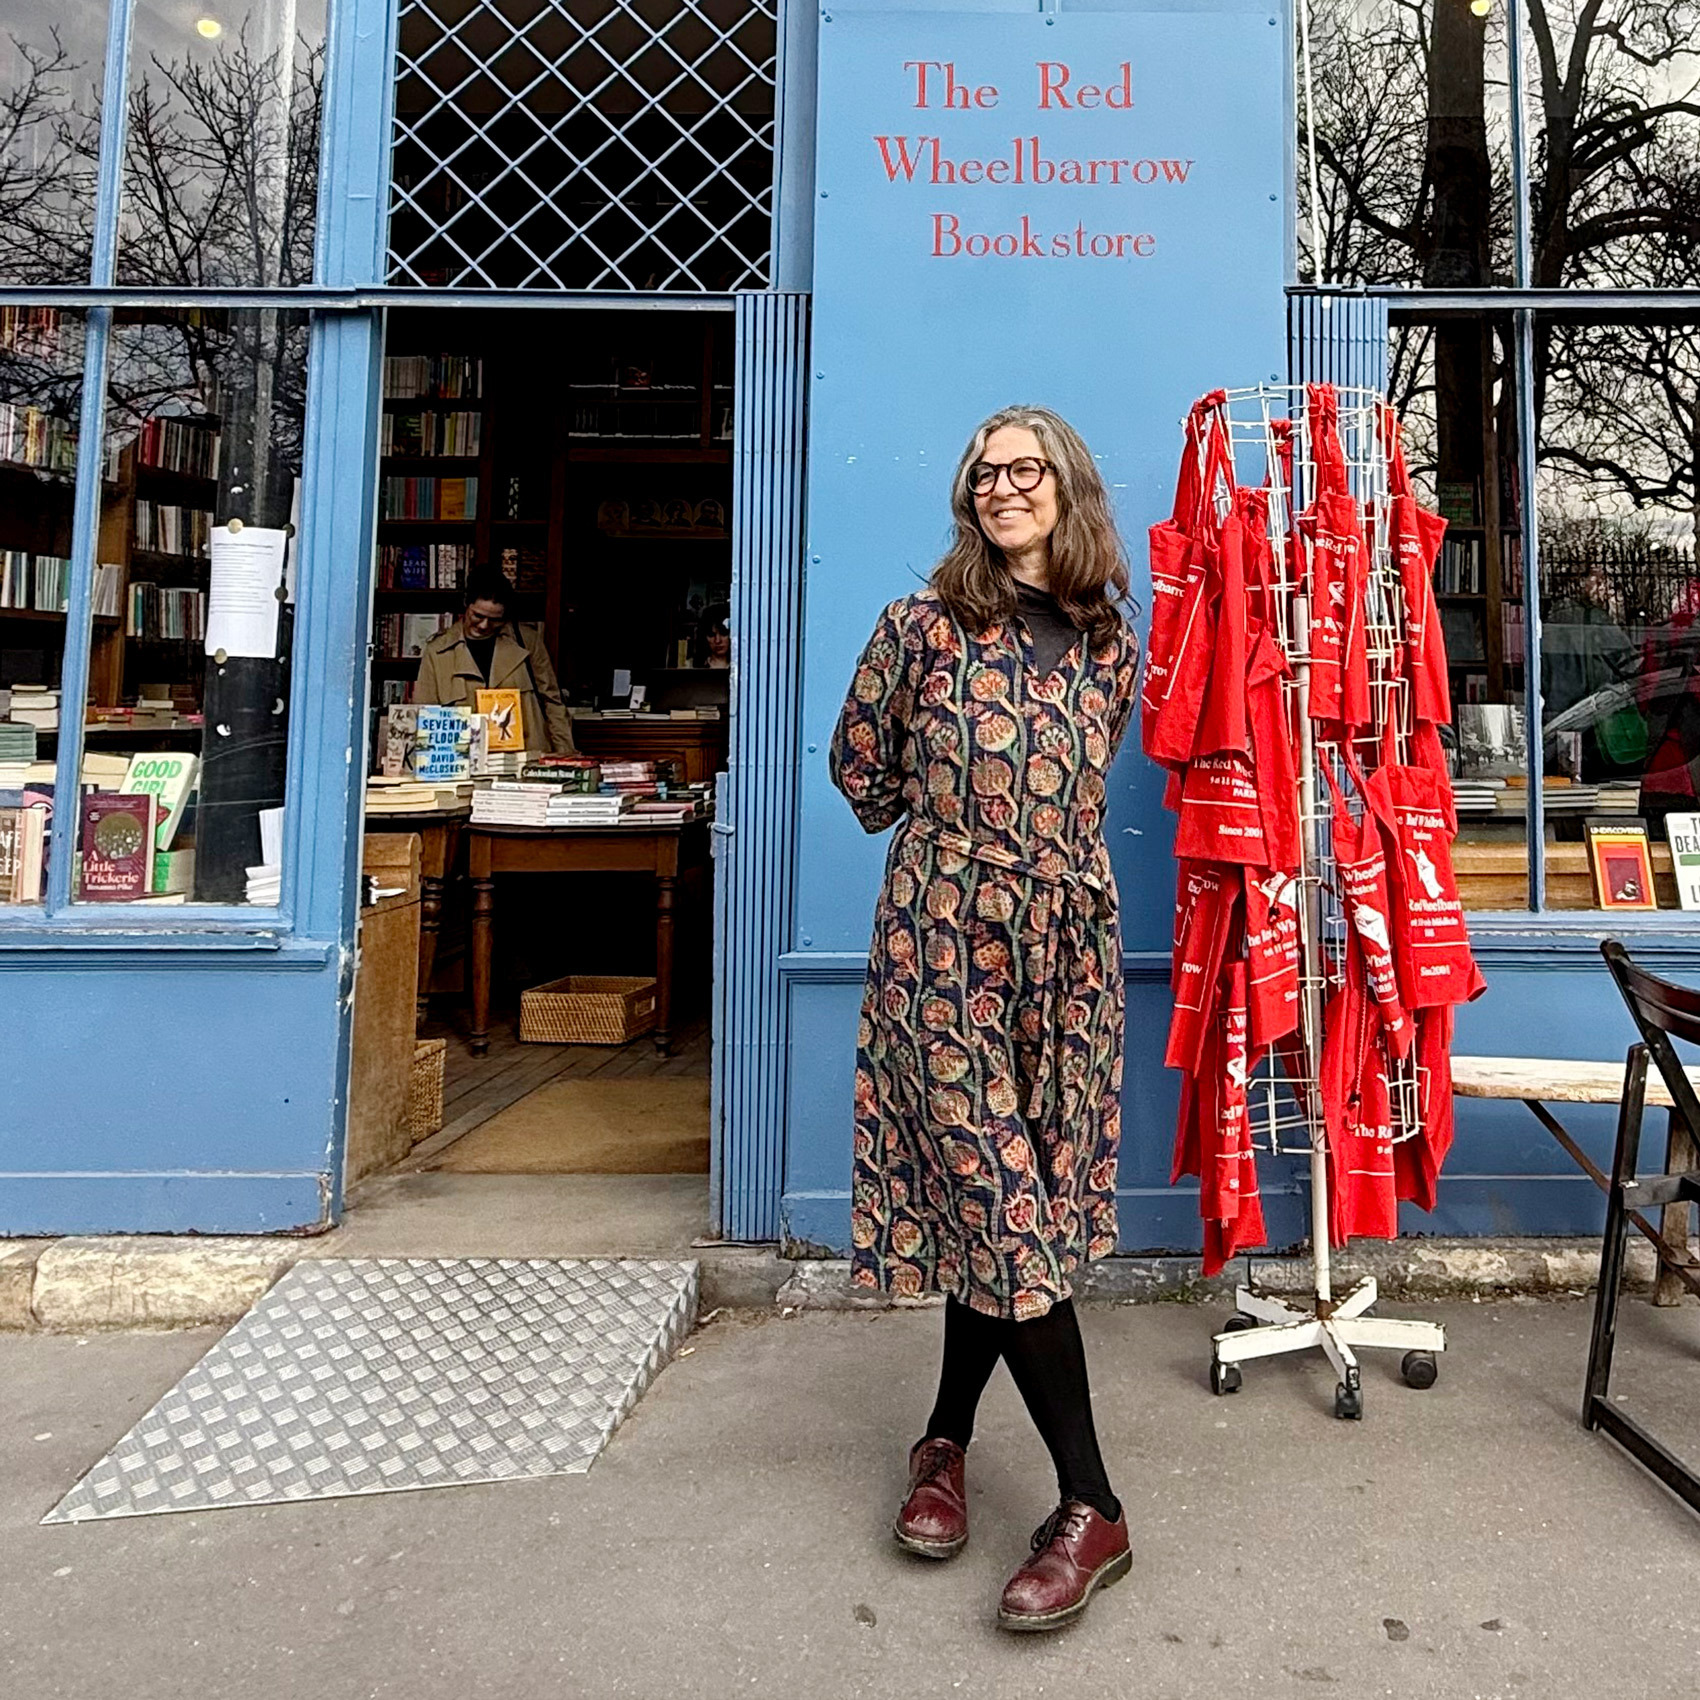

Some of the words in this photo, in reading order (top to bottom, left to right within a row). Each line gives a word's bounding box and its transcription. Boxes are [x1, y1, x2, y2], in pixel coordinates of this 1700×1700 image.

[904, 61, 999, 109] The
[1035, 61, 1134, 109] Red
[873, 135, 1196, 184] Wheelbarrow
[930, 213, 1156, 258] Bookstore
[422, 719, 468, 731] SEVENTH
[429, 732, 460, 744] FLOOR
[431, 754, 455, 763] DAVID
[131, 759, 183, 779] GOOD
[88, 850, 99, 861] A
[83, 860, 116, 872] Little
